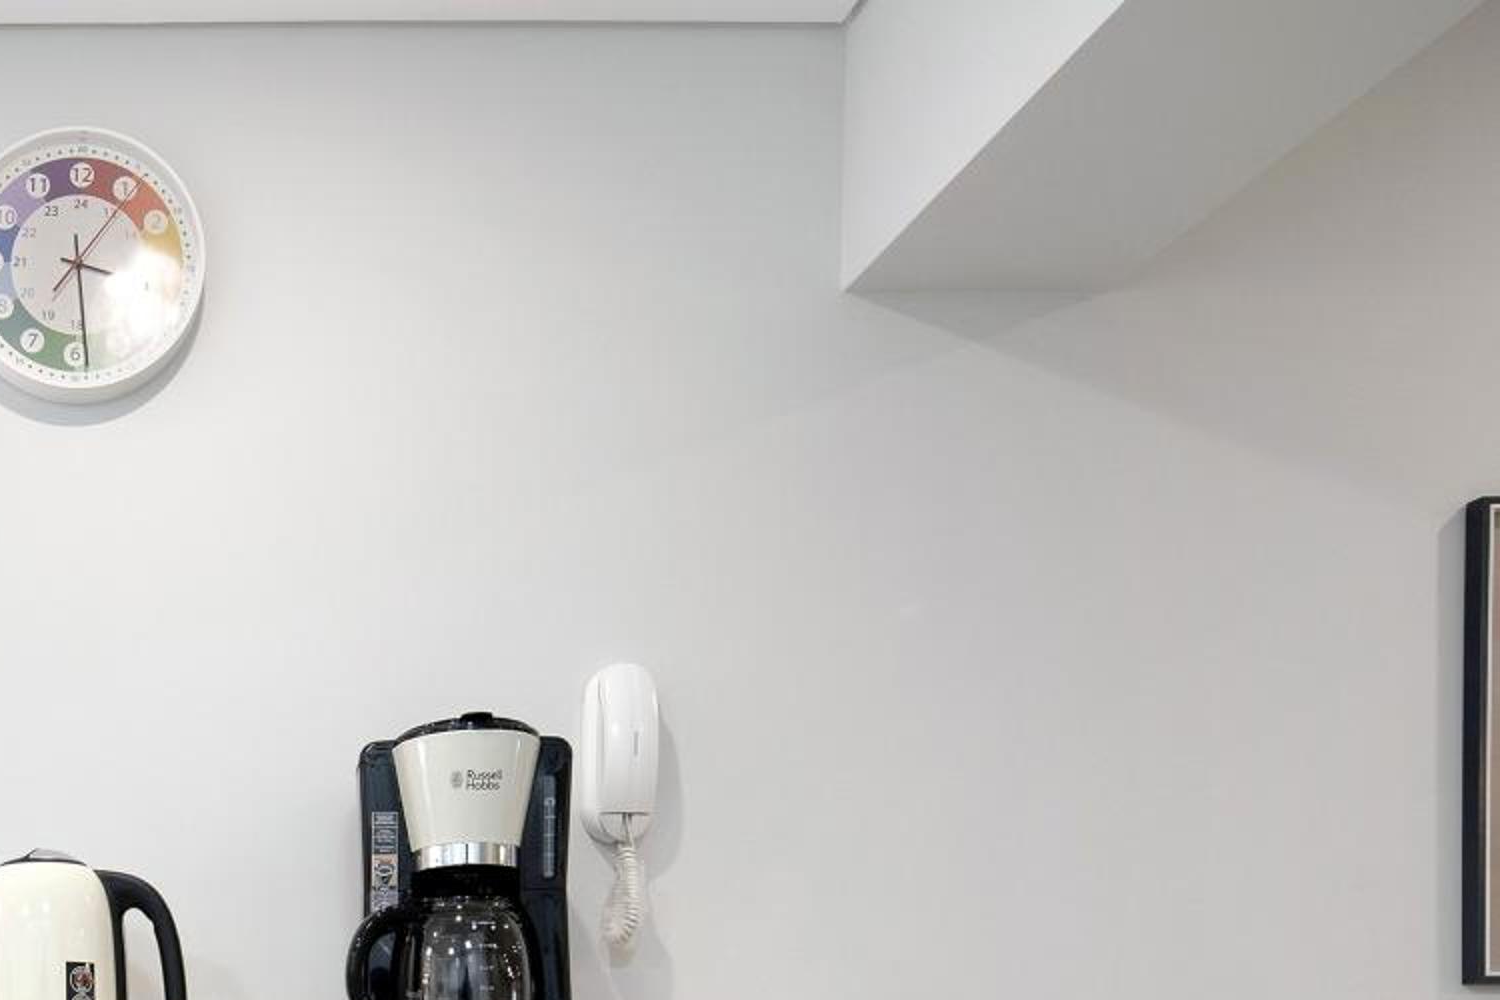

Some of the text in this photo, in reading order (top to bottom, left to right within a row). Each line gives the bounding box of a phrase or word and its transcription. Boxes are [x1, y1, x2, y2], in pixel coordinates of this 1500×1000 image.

[73, 167, 93, 183] 12
[30, 177, 47, 193] 11
[44, 205, 59, 217] 23
[28, 332, 39, 348] 7
[69, 345, 81, 361] 6
[467, 769, 502, 781] Russell
[467, 780, 501, 791] Hobbs
